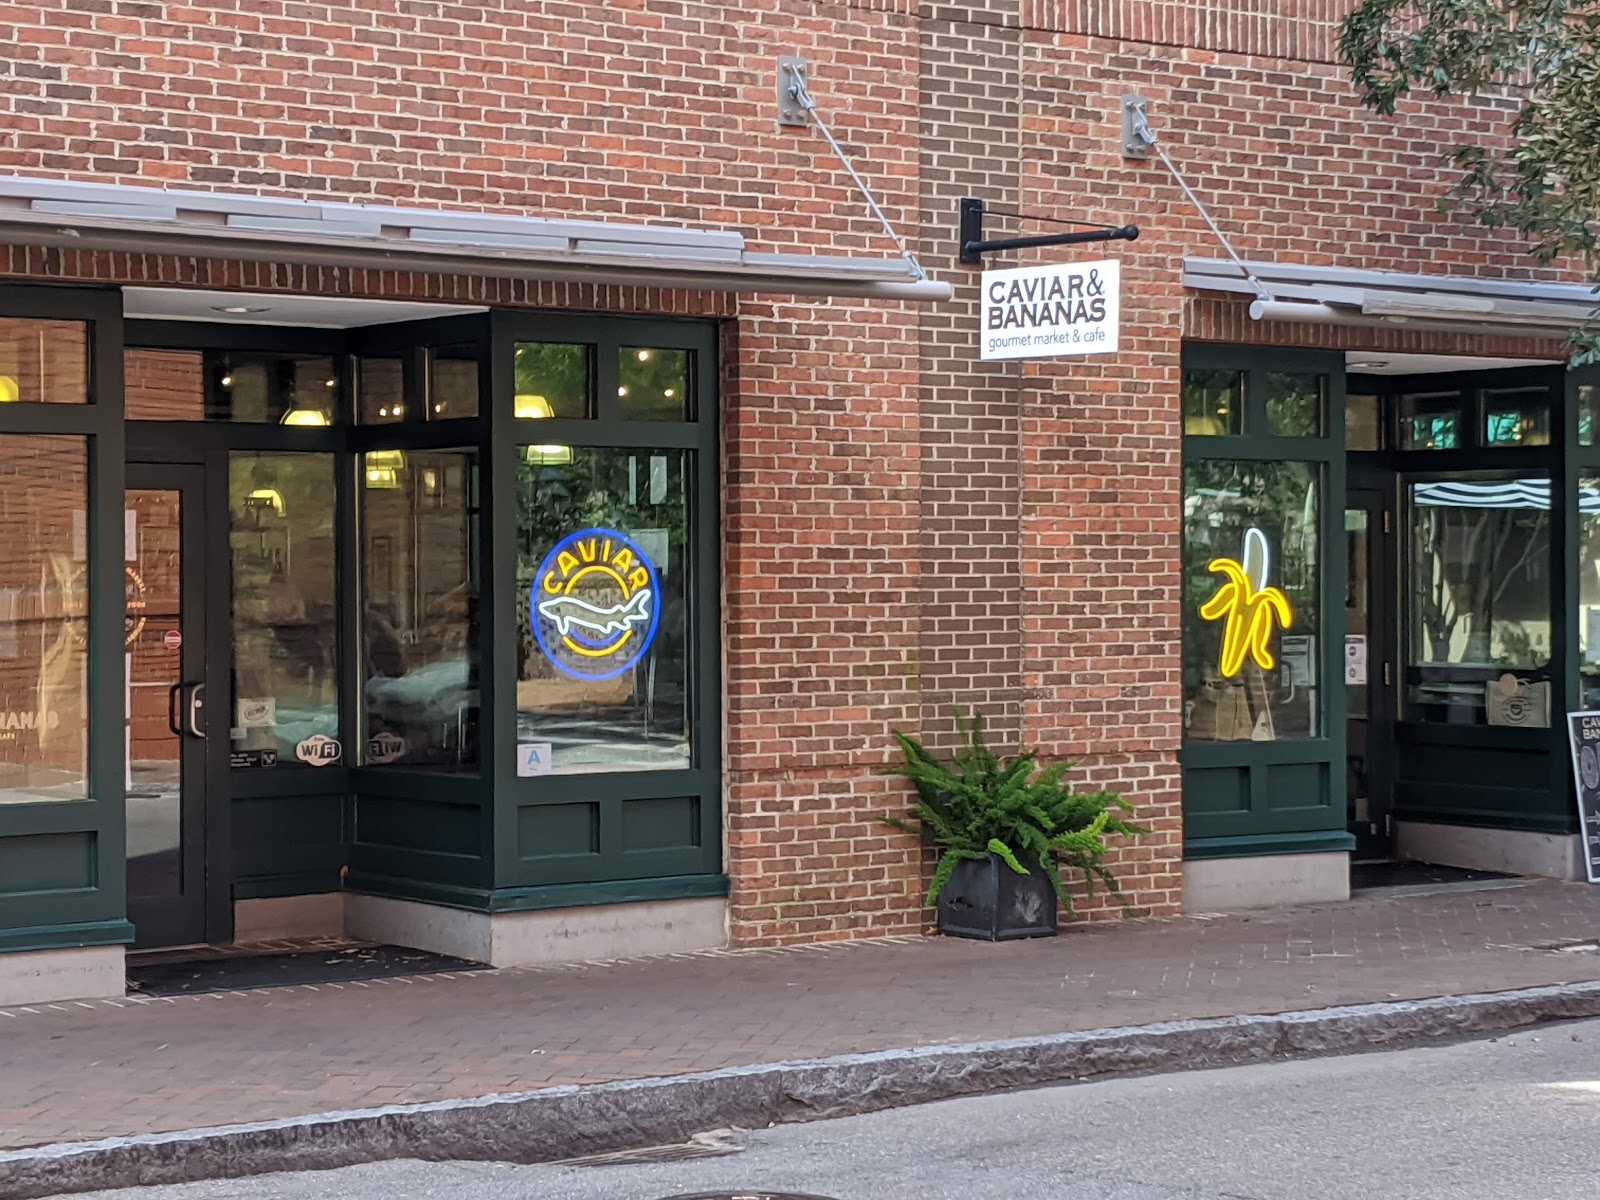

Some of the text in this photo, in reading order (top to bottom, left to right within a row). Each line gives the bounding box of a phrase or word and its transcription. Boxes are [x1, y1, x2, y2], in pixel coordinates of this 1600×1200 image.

[987, 298, 1106, 330] BANANAS
[988, 326, 1106, 353] gourmet market & cafe
[543, 539, 649, 594] CAVIAR
[527, 749, 541, 765] A
